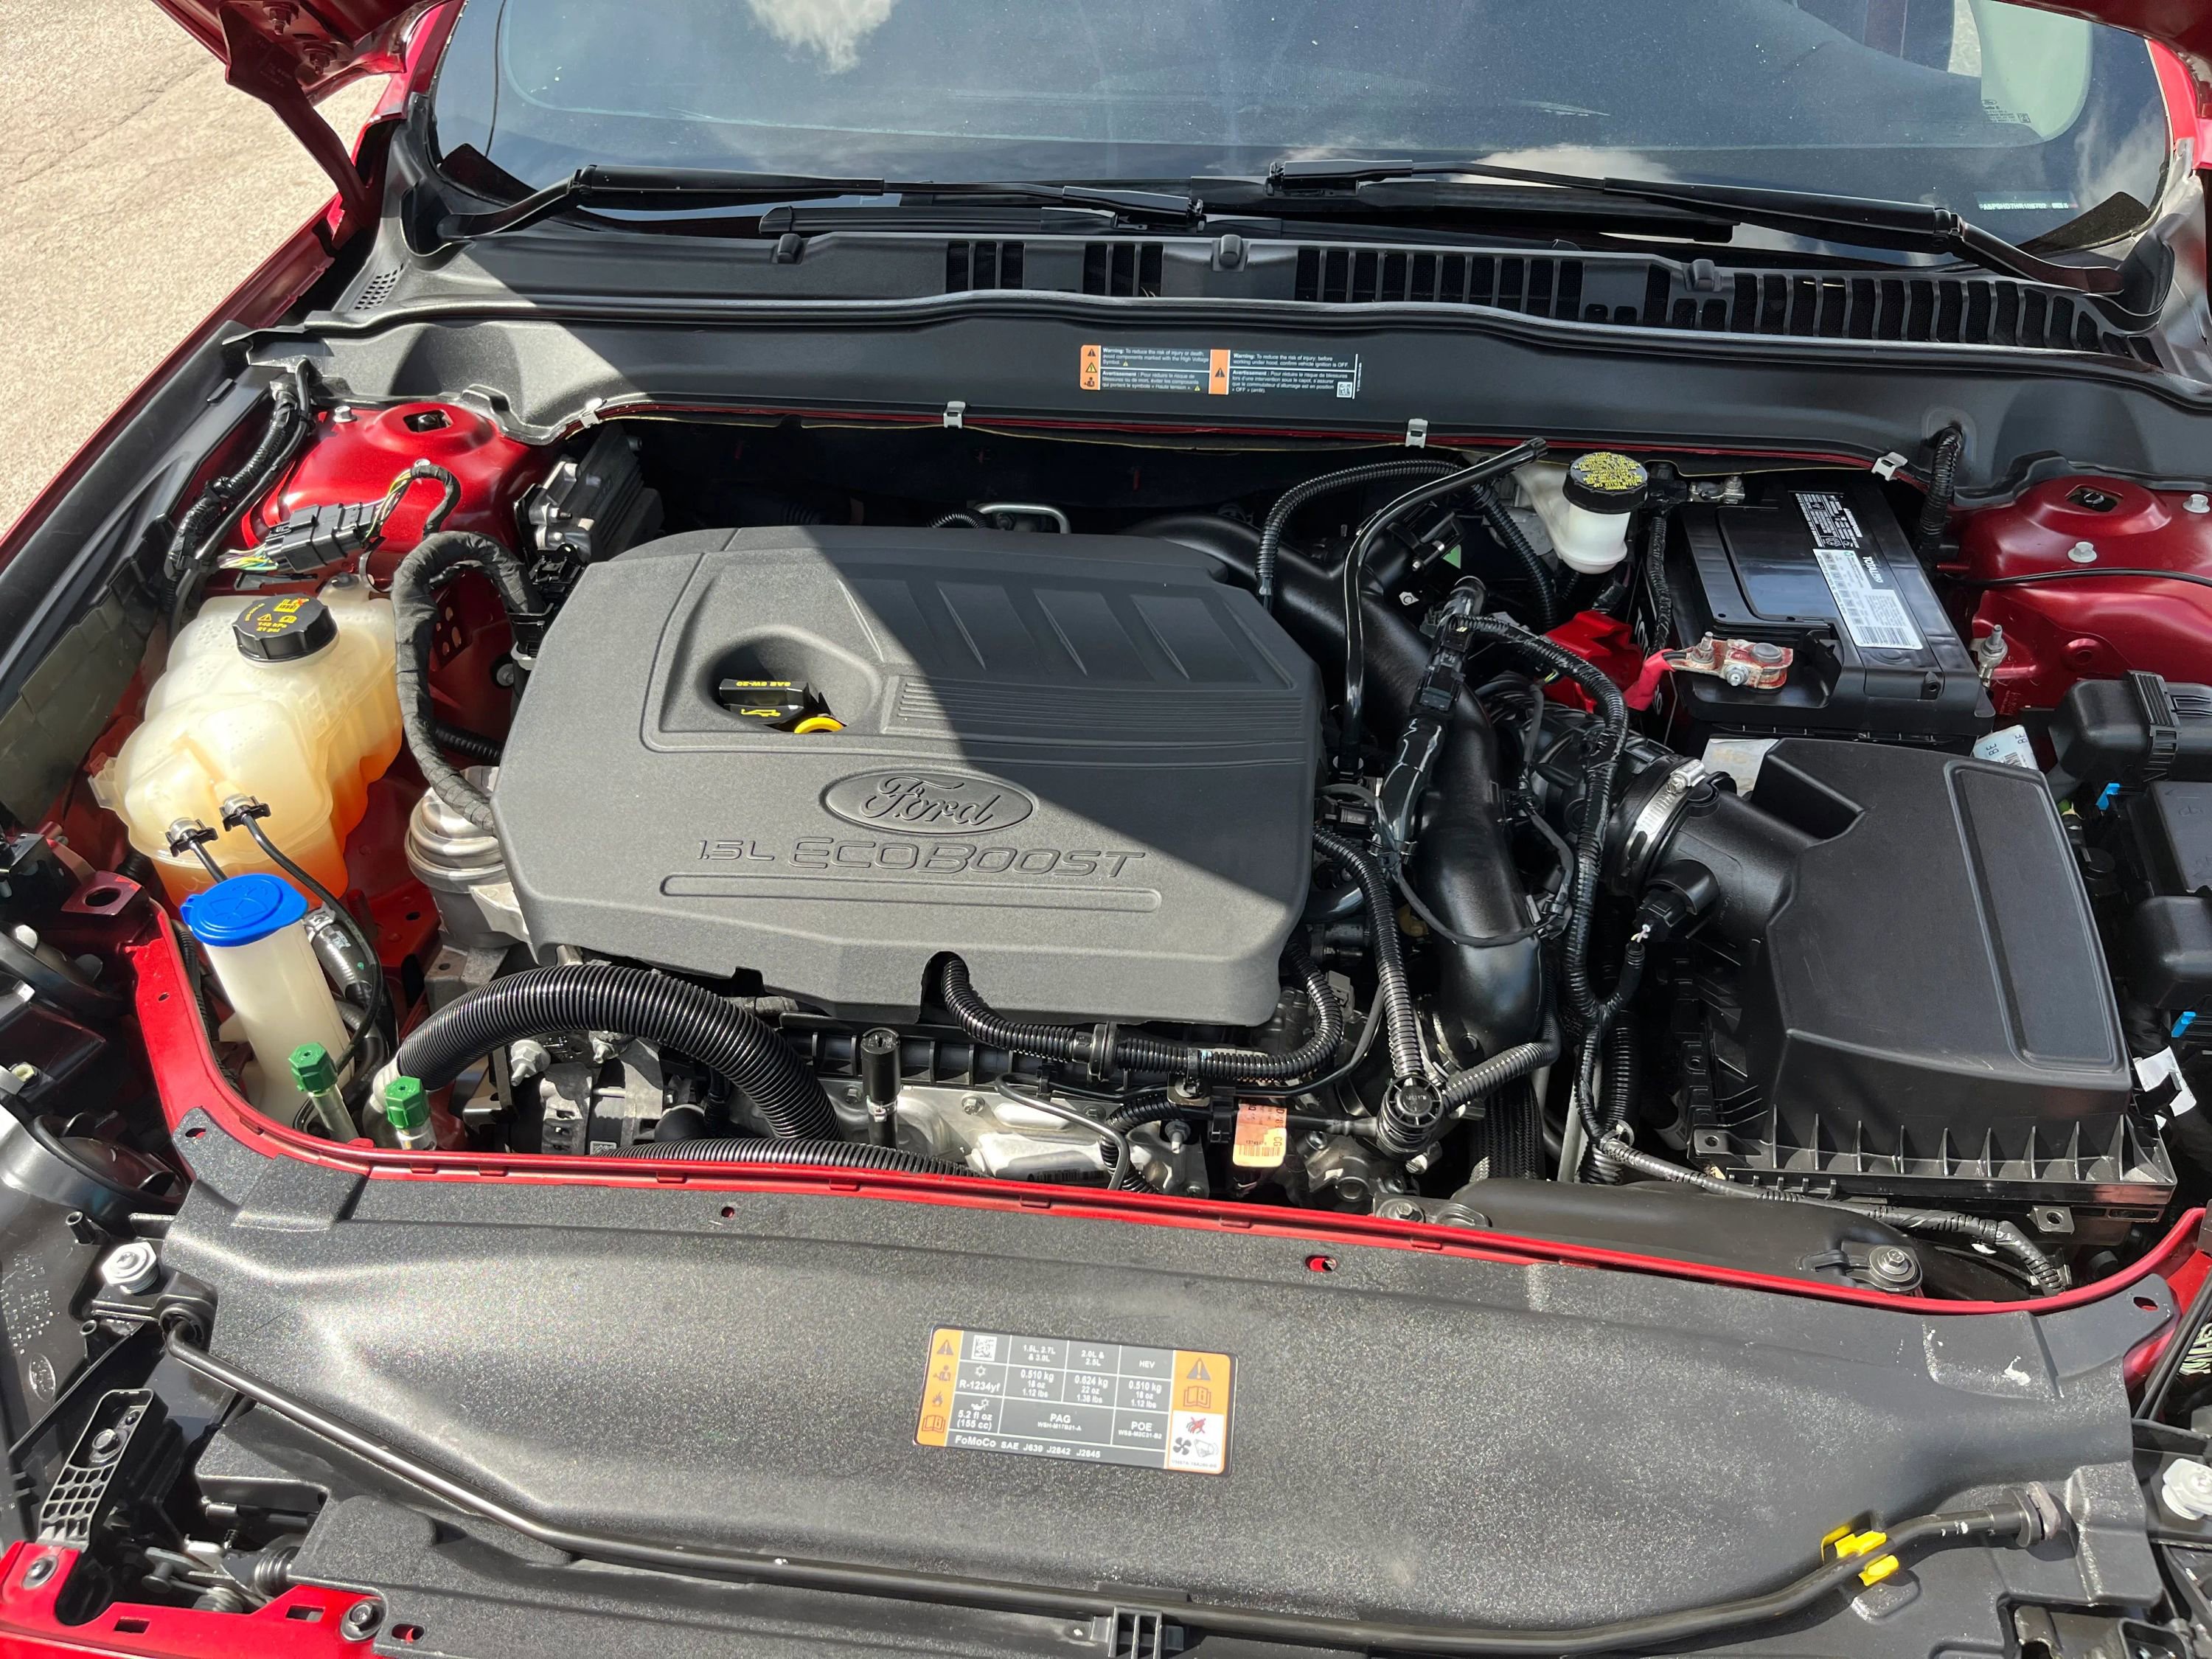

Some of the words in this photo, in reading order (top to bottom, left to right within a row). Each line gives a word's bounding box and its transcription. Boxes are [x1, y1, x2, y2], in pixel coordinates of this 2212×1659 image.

[1986, 743, 2000, 756] BE
[860, 776, 1002, 827] Ford
[696, 839, 776, 861] 1.5L
[788, 837, 1147, 878] ECOBOOST
[1041, 1346, 1056, 1354] 2.7L
[1081, 1350, 1097, 1359] 2.0L
[1036, 1354, 1051, 1363] 3.0L
[1138, 1360, 1155, 1369] HEV
[1020, 1369, 1043, 1381] 0.510
[1043, 1371, 1054, 1383] kg
[1074, 1374, 1096, 1386] 0.624
[1096, 1377, 1108, 1388] kg
[959, 1380, 1001, 1393] R-1234yf
[1027, 1380, 1035, 1388] 18
[1128, 1380, 1150, 1391] 0.510
[1150, 1382, 1162, 1394] kg
[1022, 1388, 1036, 1397] 1.12
[1037, 1389, 1048, 1398] lbs
[1081, 1385, 1091, 1394] 22
[1091, 1395, 1103, 1403] lbs
[1130, 1399, 1144, 1407] 1.12
[1145, 1400, 1157, 1408] lbs
[958, 1411, 972, 1419] 5.2
[1050, 1413, 1071, 1424] PAG
[956, 1419, 974, 1429] (155
[975, 1421, 992, 1430] cc)
[1131, 1422, 1152, 1432] POE
[955, 1436, 996, 1449] FoMoCo
[1001, 1441, 1019, 1450] SAE
[1023, 1443, 1043, 1453] J639
